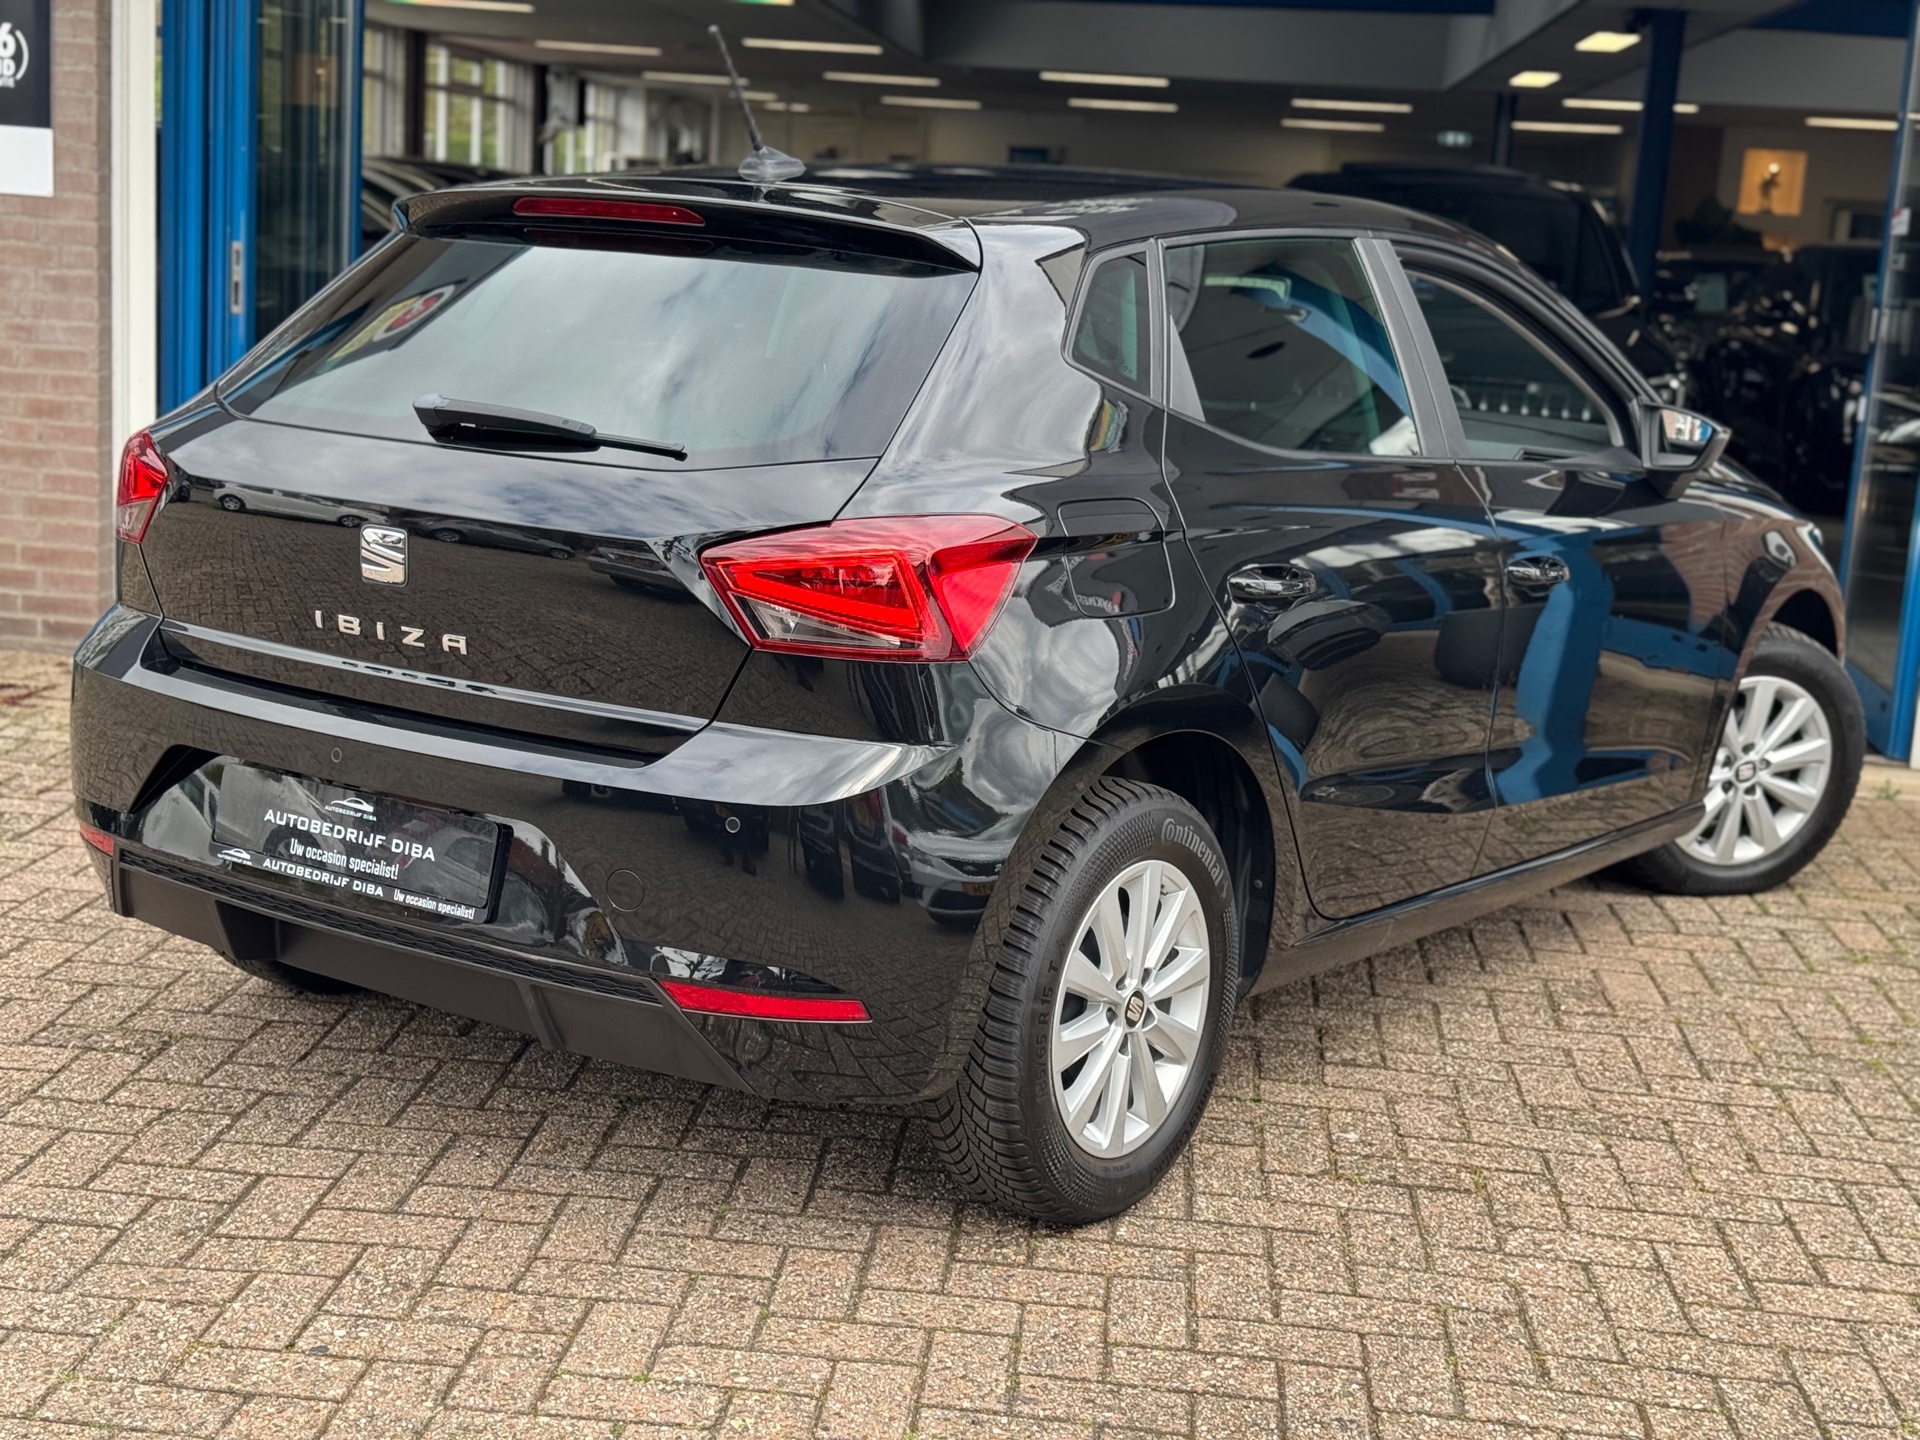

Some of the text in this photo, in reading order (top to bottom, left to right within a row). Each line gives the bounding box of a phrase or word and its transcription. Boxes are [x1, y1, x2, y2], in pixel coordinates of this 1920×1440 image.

[315, 610, 468, 655] IBIZA
[264, 809, 436, 862] AUTOBEDRIJF DIBA
[1161, 818, 1224, 888] Continental
[263, 858, 350, 888] AUTOBEDRIJF
[353, 879, 384, 898] DIBA
[289, 838, 399, 880] Uw occasion specialist!
[394, 888, 475, 920] Uw occasion specialist!
